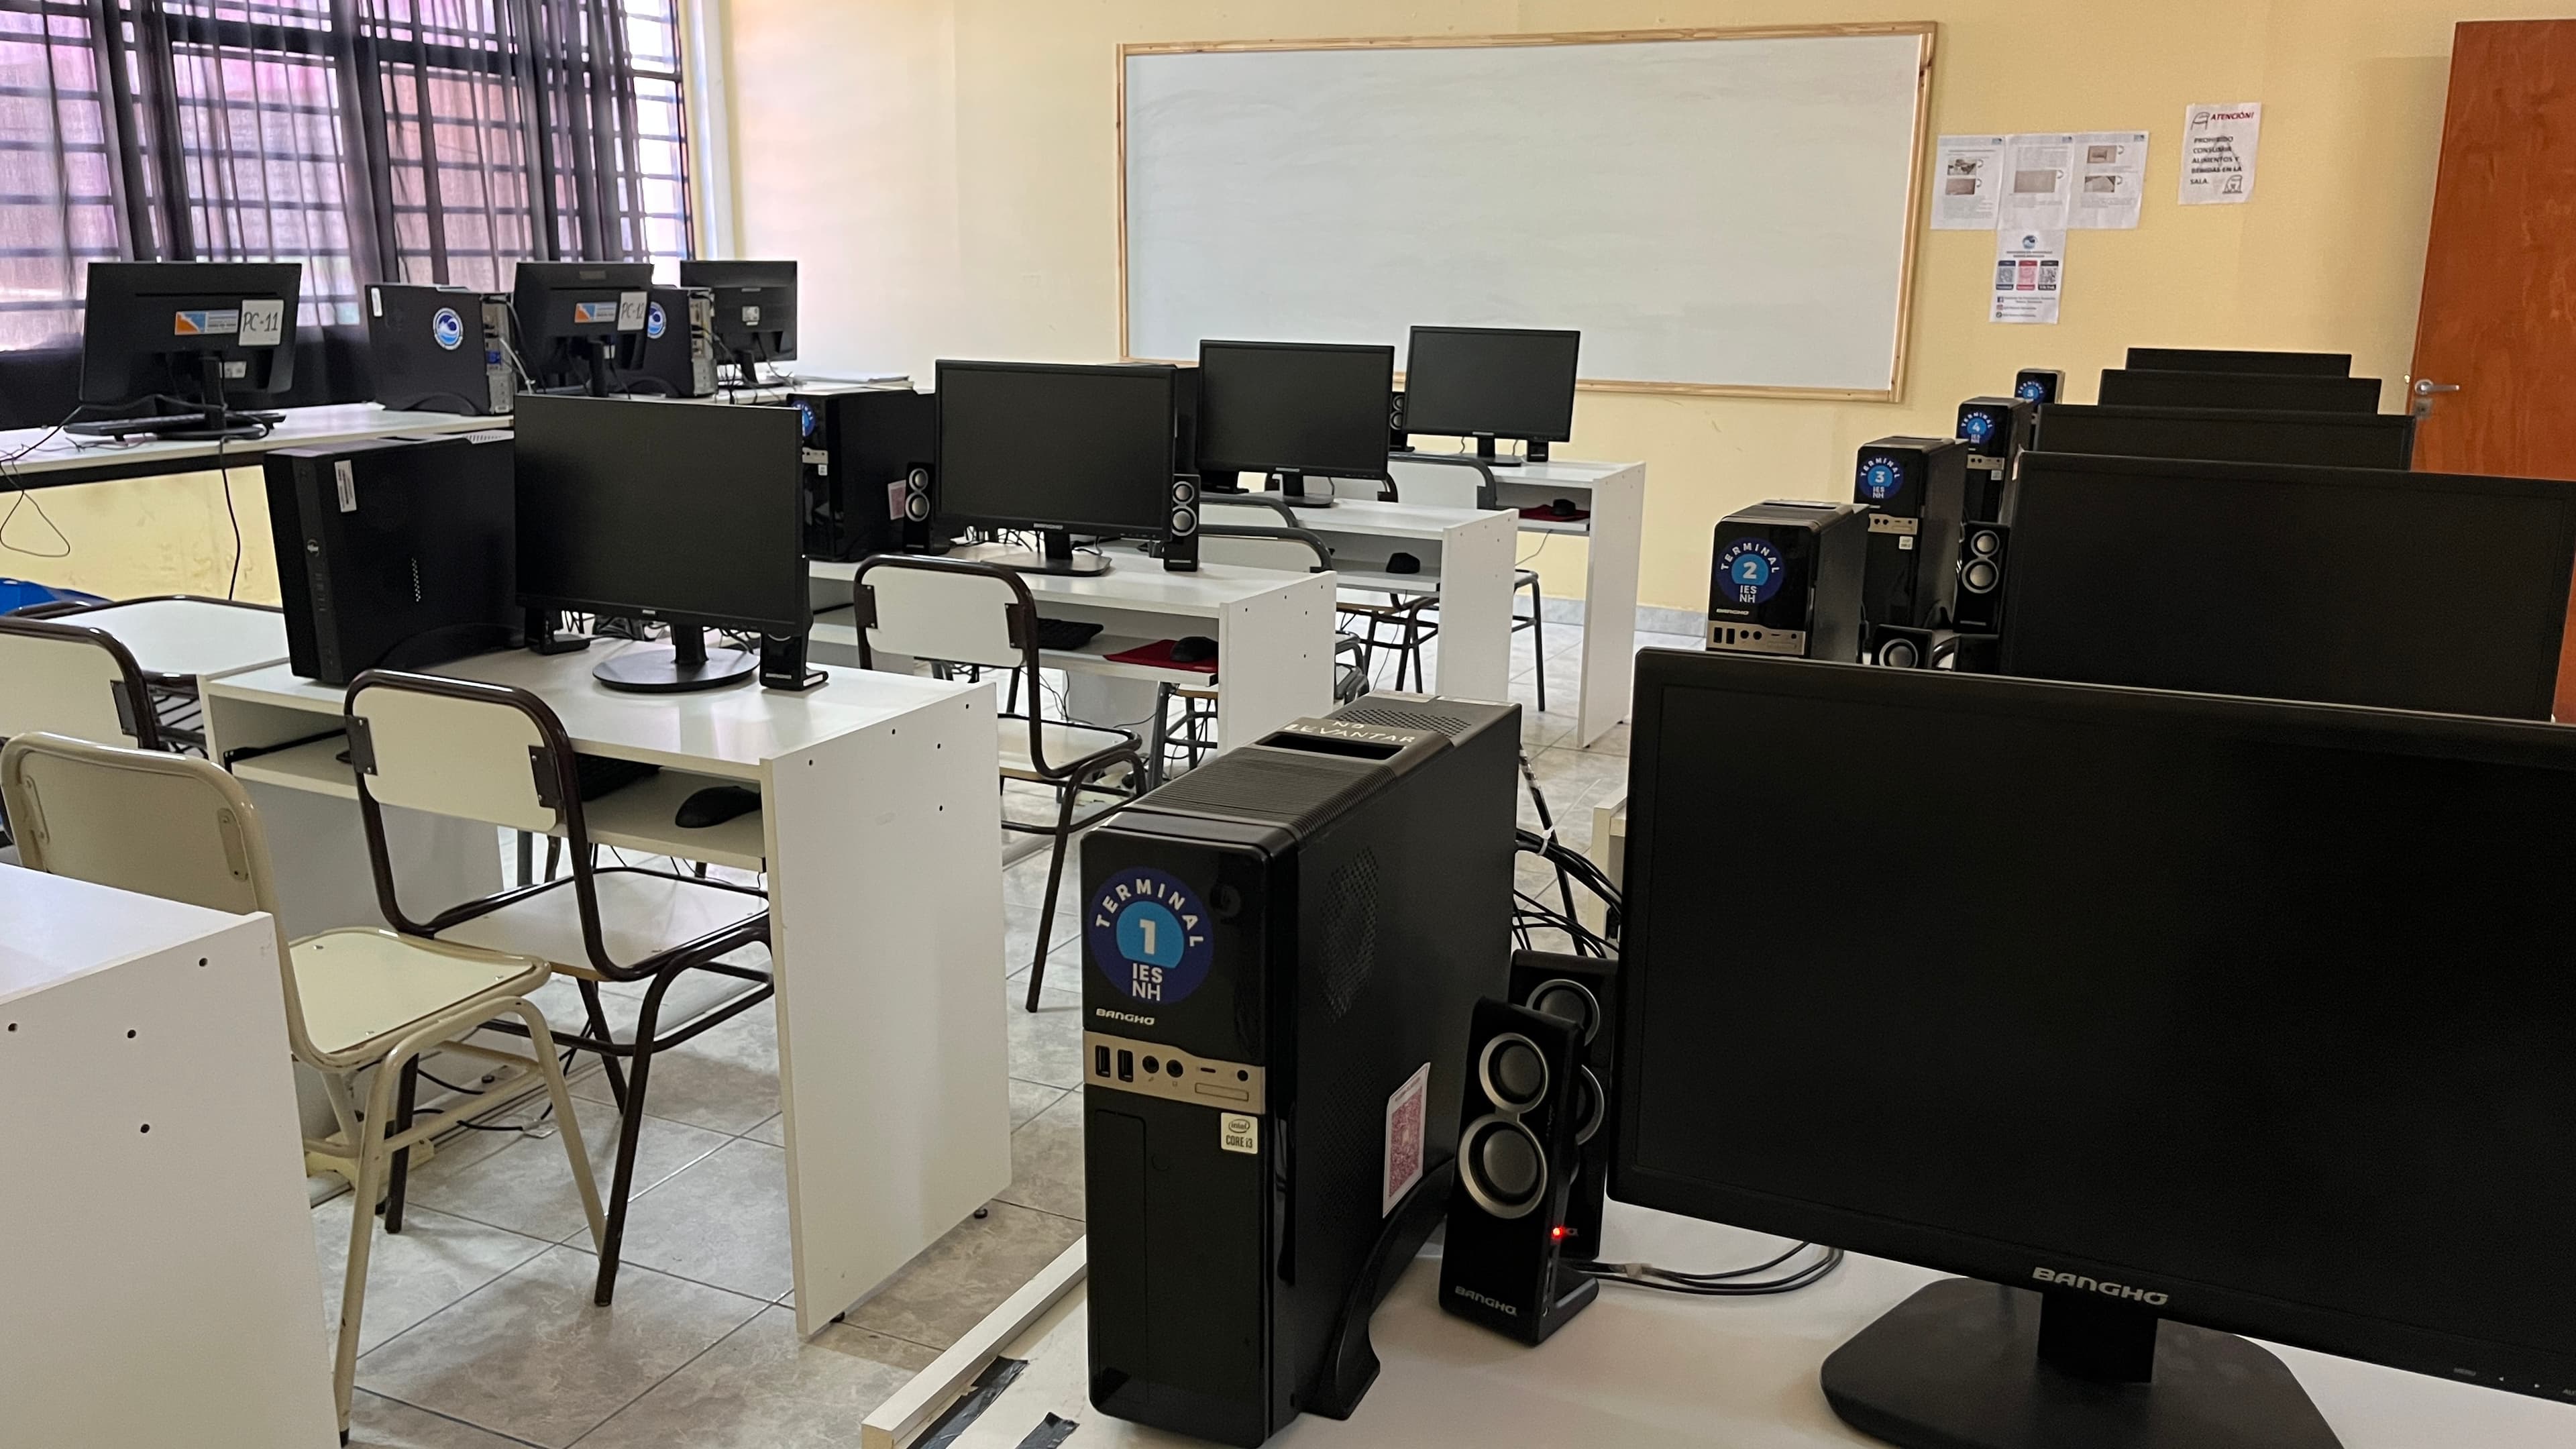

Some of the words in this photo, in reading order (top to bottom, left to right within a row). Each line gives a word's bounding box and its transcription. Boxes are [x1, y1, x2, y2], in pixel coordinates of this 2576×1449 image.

[621, 302, 644, 319] PC-12
[243, 311, 278, 333] PC-11
[1860, 458, 1900, 478] TERMINAL
[1875, 471, 1885, 483] 3
[1721, 543, 1780, 573] TERMINAL
[1743, 561, 1757, 580] 2
[1739, 594, 1755, 603] NH
[1740, 585, 1757, 594] IES
[1284, 724, 1415, 743] LEVANTAR
[1095, 878, 1204, 947] TERMINAL
[1140, 918, 1156, 955] 1
[1132, 963, 1163, 983] IES
[1132, 980, 1161, 1002] NH
[1226, 1134, 1244, 1147] CORE
[1245, 1138, 1252, 1148] i3
